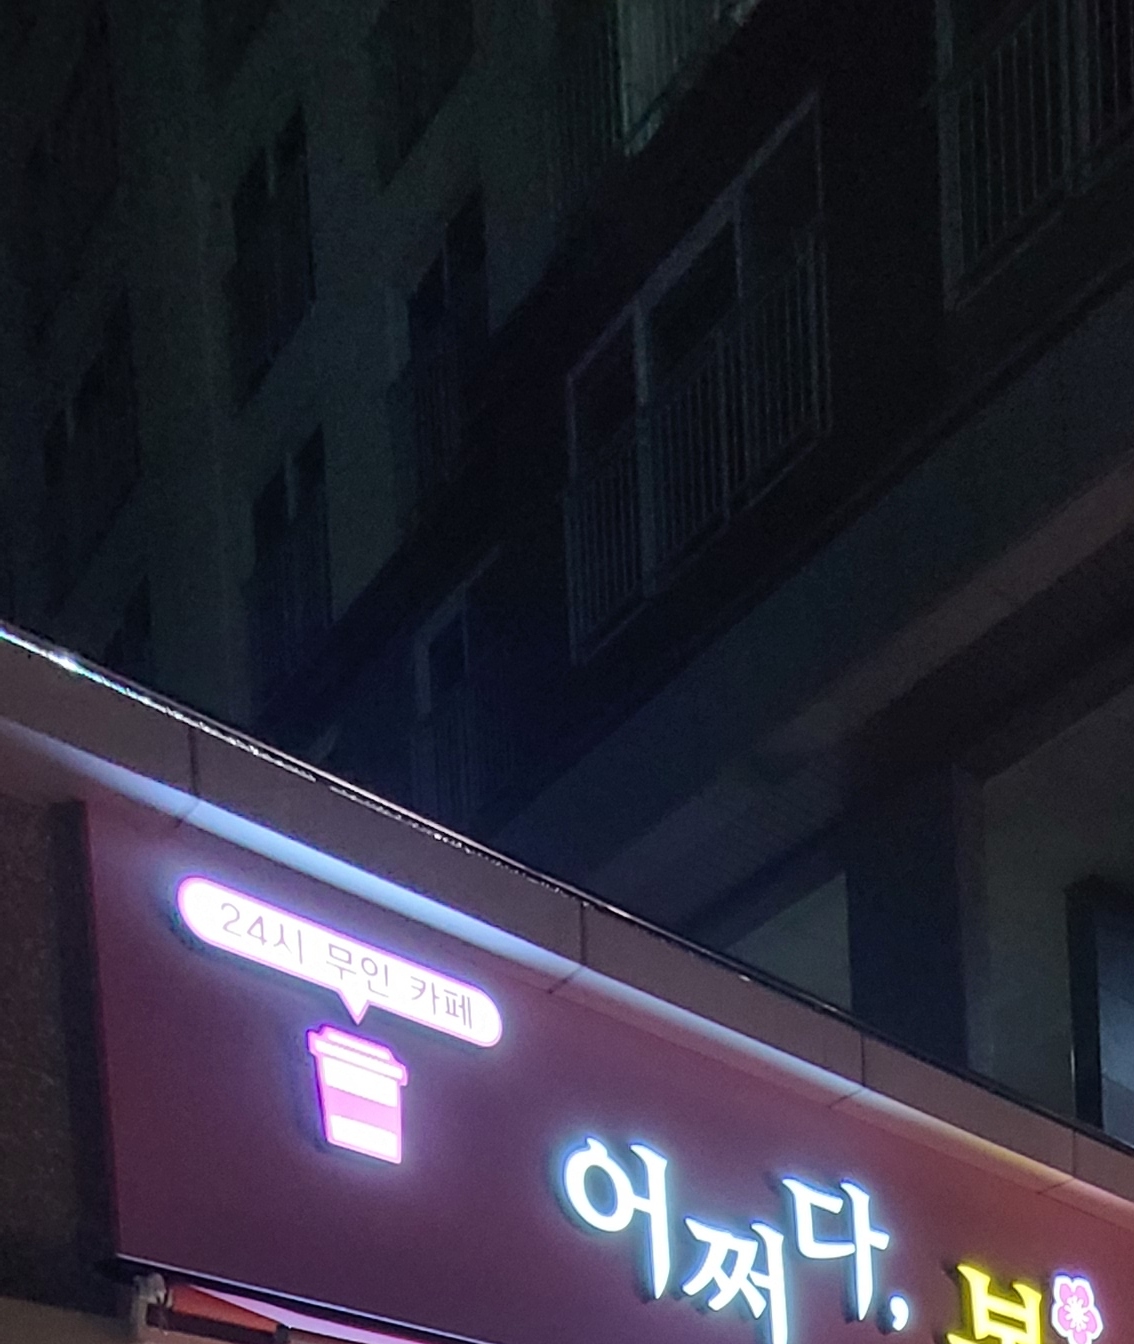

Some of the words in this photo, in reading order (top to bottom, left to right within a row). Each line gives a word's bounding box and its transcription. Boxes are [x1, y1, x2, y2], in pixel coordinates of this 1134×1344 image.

[219, 902, 304, 964] 24시
[324, 942, 390, 997] 무인
[409, 974, 474, 1030] 카페
